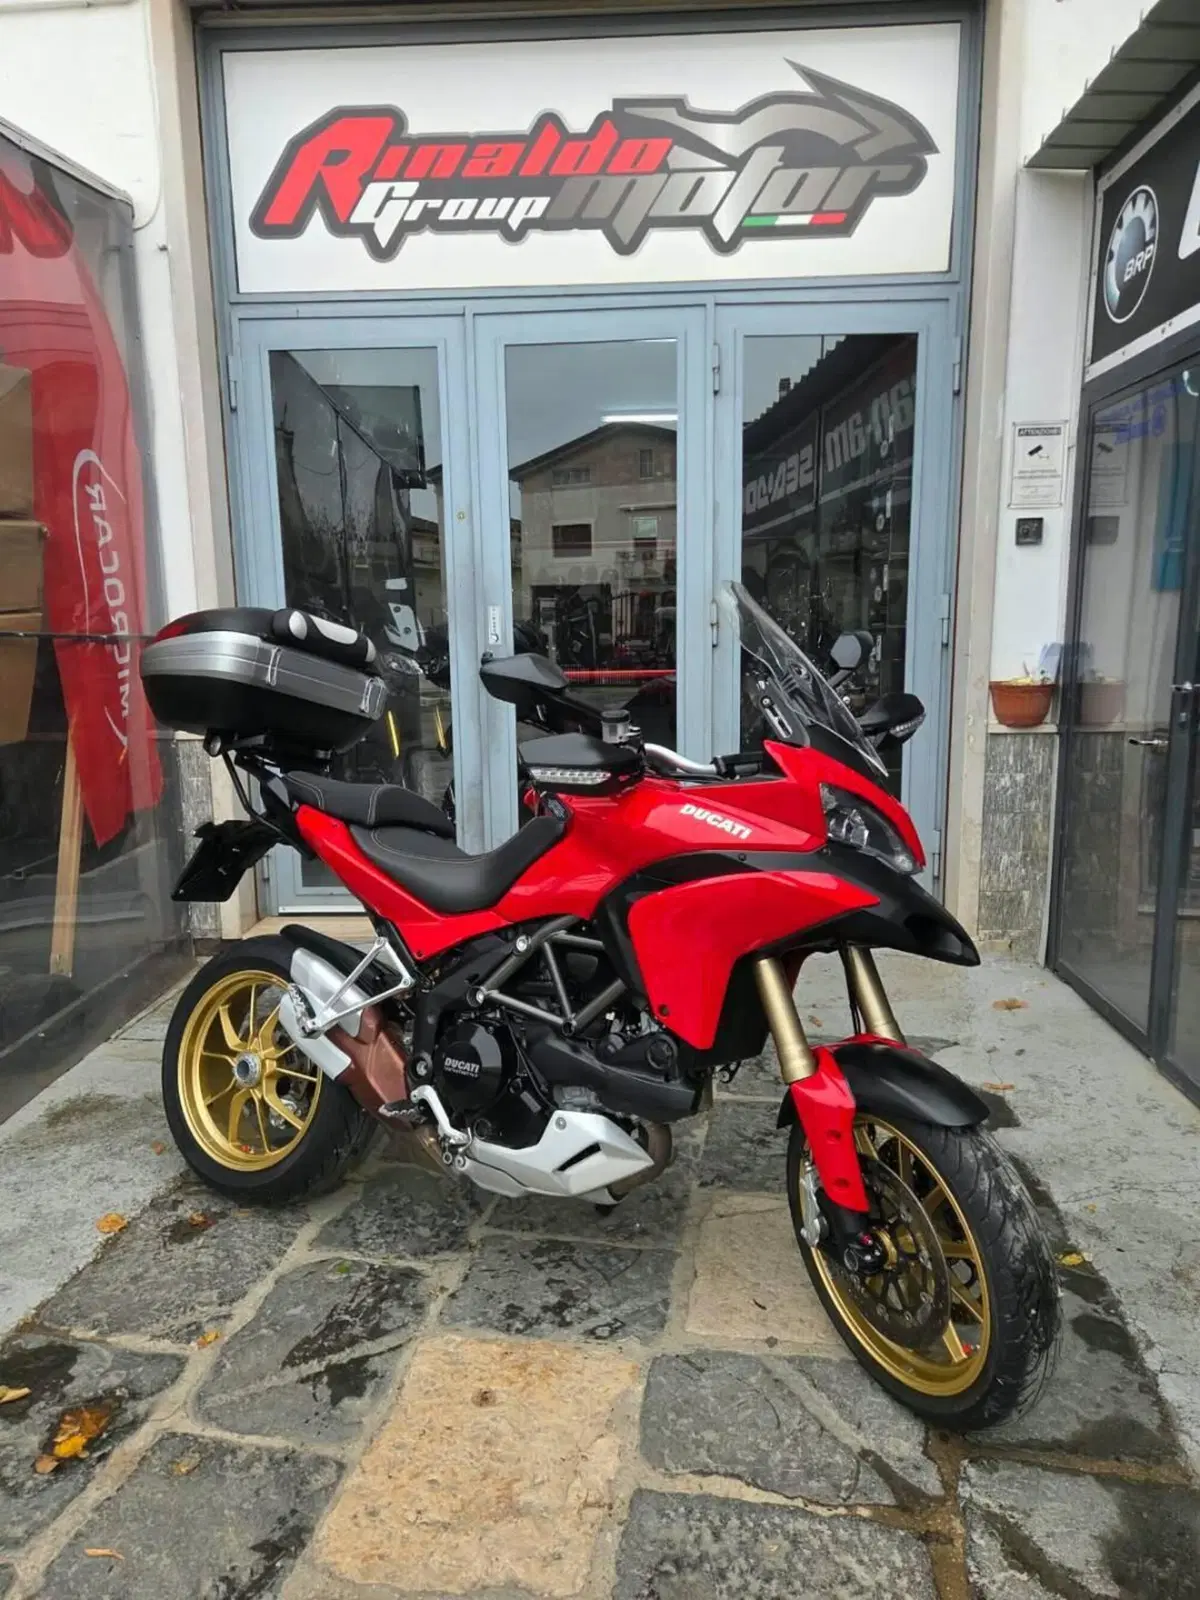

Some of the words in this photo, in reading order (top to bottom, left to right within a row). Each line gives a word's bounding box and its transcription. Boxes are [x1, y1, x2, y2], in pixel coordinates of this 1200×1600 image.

[264, 115, 673, 225] Rinaldo
[349, 180, 551, 248] Group
[1124, 243, 1154, 282] BRP
[680, 803, 753, 840] DUCATI
[445, 1057, 480, 1073] DUCATI
